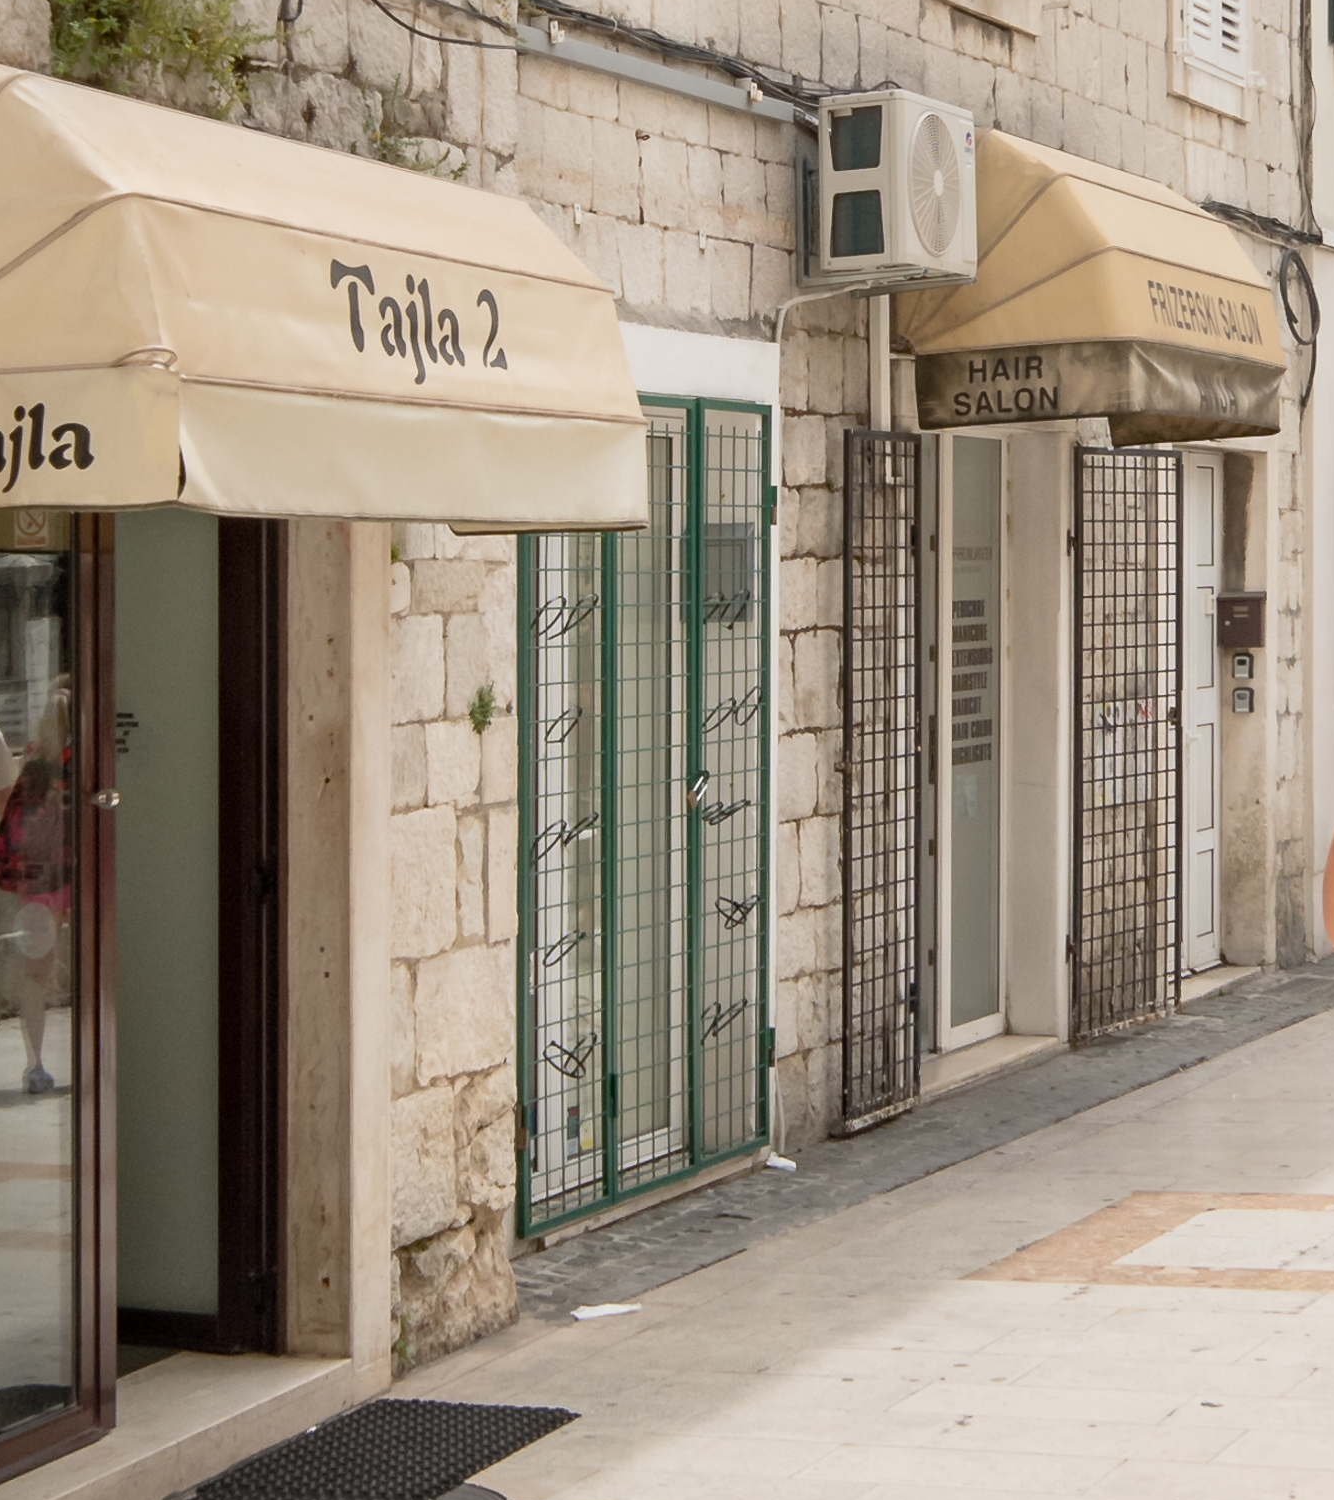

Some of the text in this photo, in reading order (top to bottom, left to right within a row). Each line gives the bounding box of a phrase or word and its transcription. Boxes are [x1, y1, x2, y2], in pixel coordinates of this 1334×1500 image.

[330, 258, 508, 385] Tajla 2
[1147, 279, 1264, 347] FRIZERSKI SALON
[968, 355, 1043, 384] HAIR
[953, 386, 1059, 417] SALON
